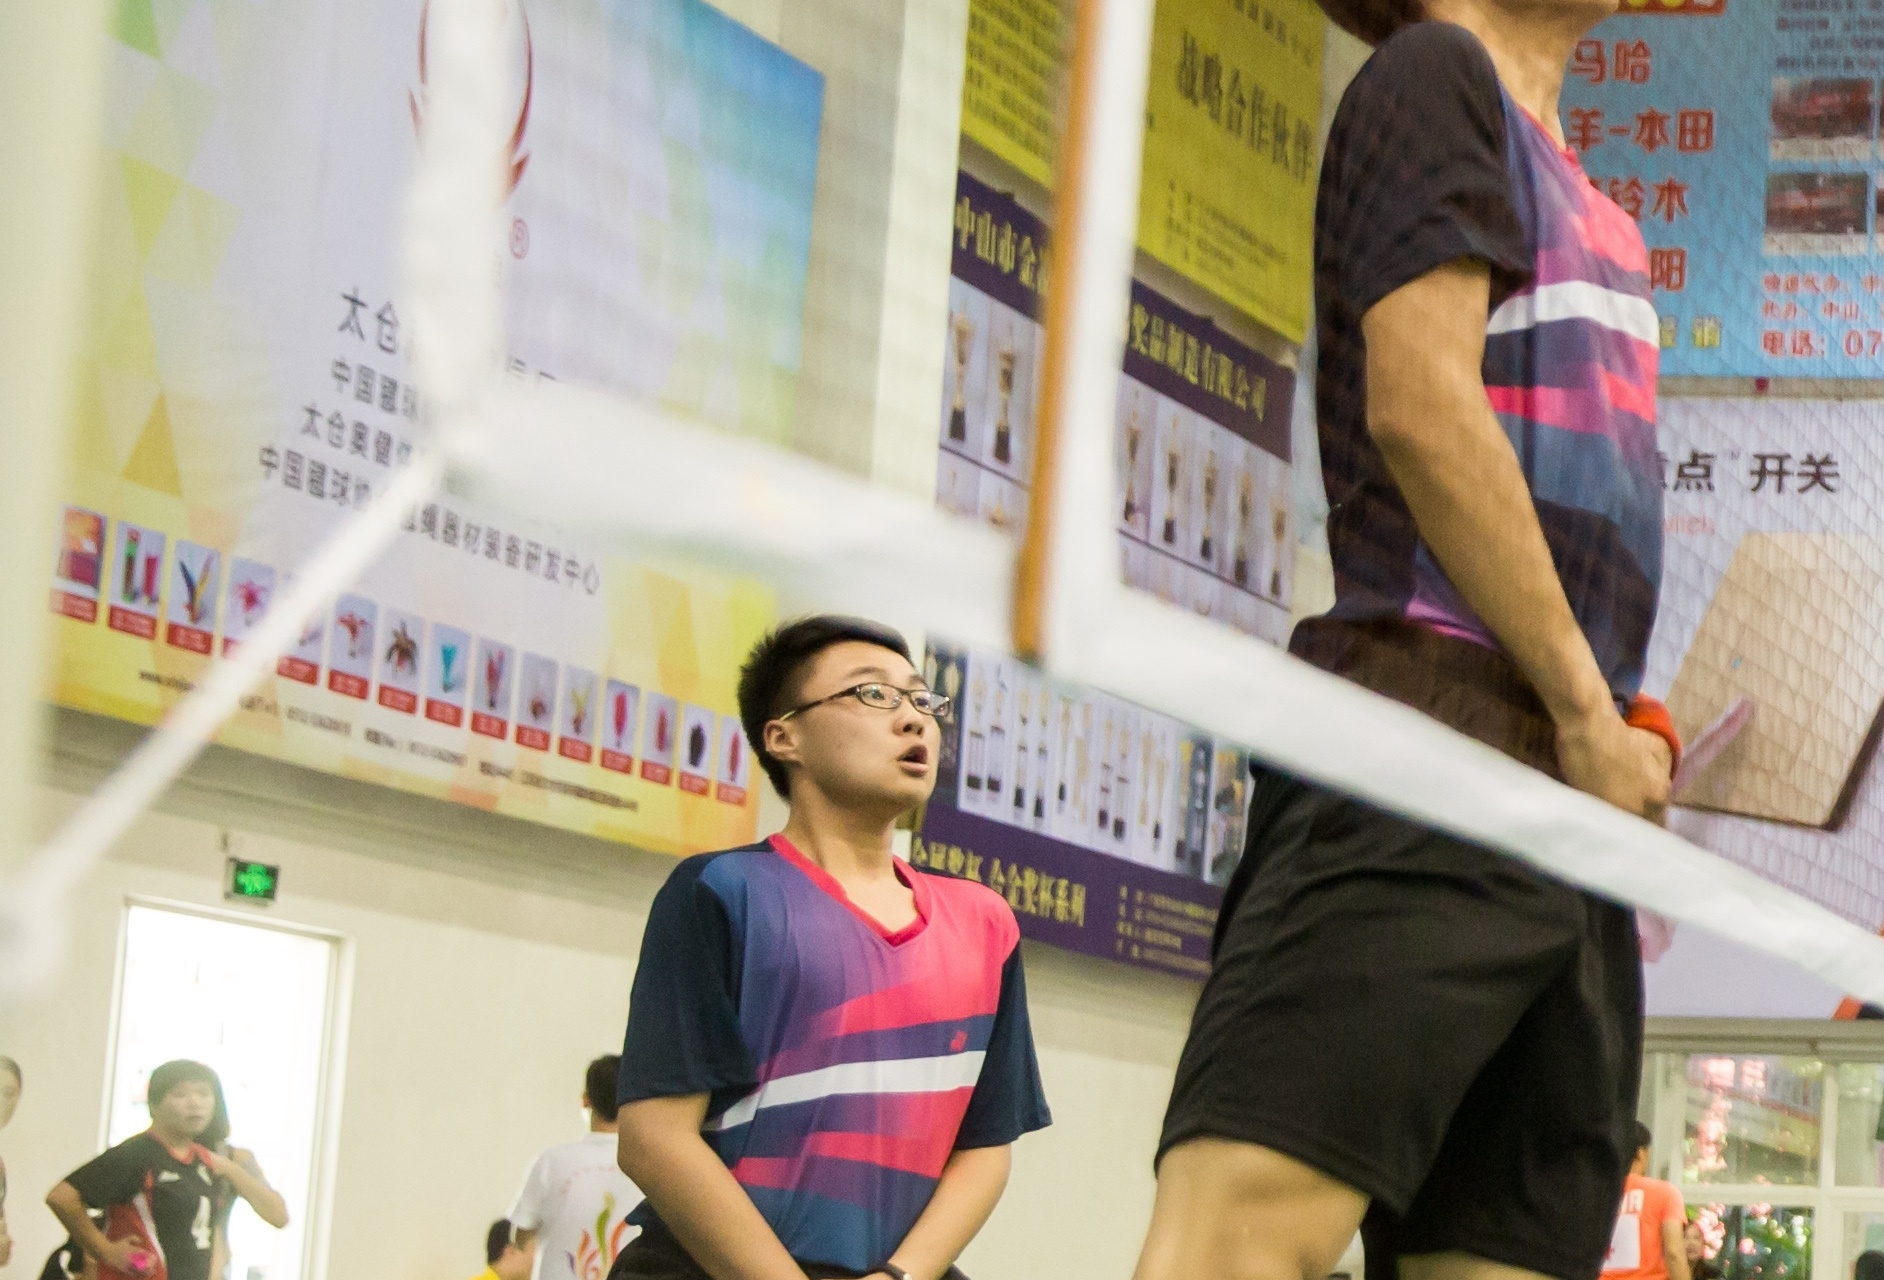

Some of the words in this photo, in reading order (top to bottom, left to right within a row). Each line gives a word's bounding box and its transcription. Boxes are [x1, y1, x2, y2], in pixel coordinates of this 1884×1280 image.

[1570, 39, 1652, 85] 马哈
[1567, 107, 1715, 155] 羊-本田
[1749, 452, 1840, 494] 开关
